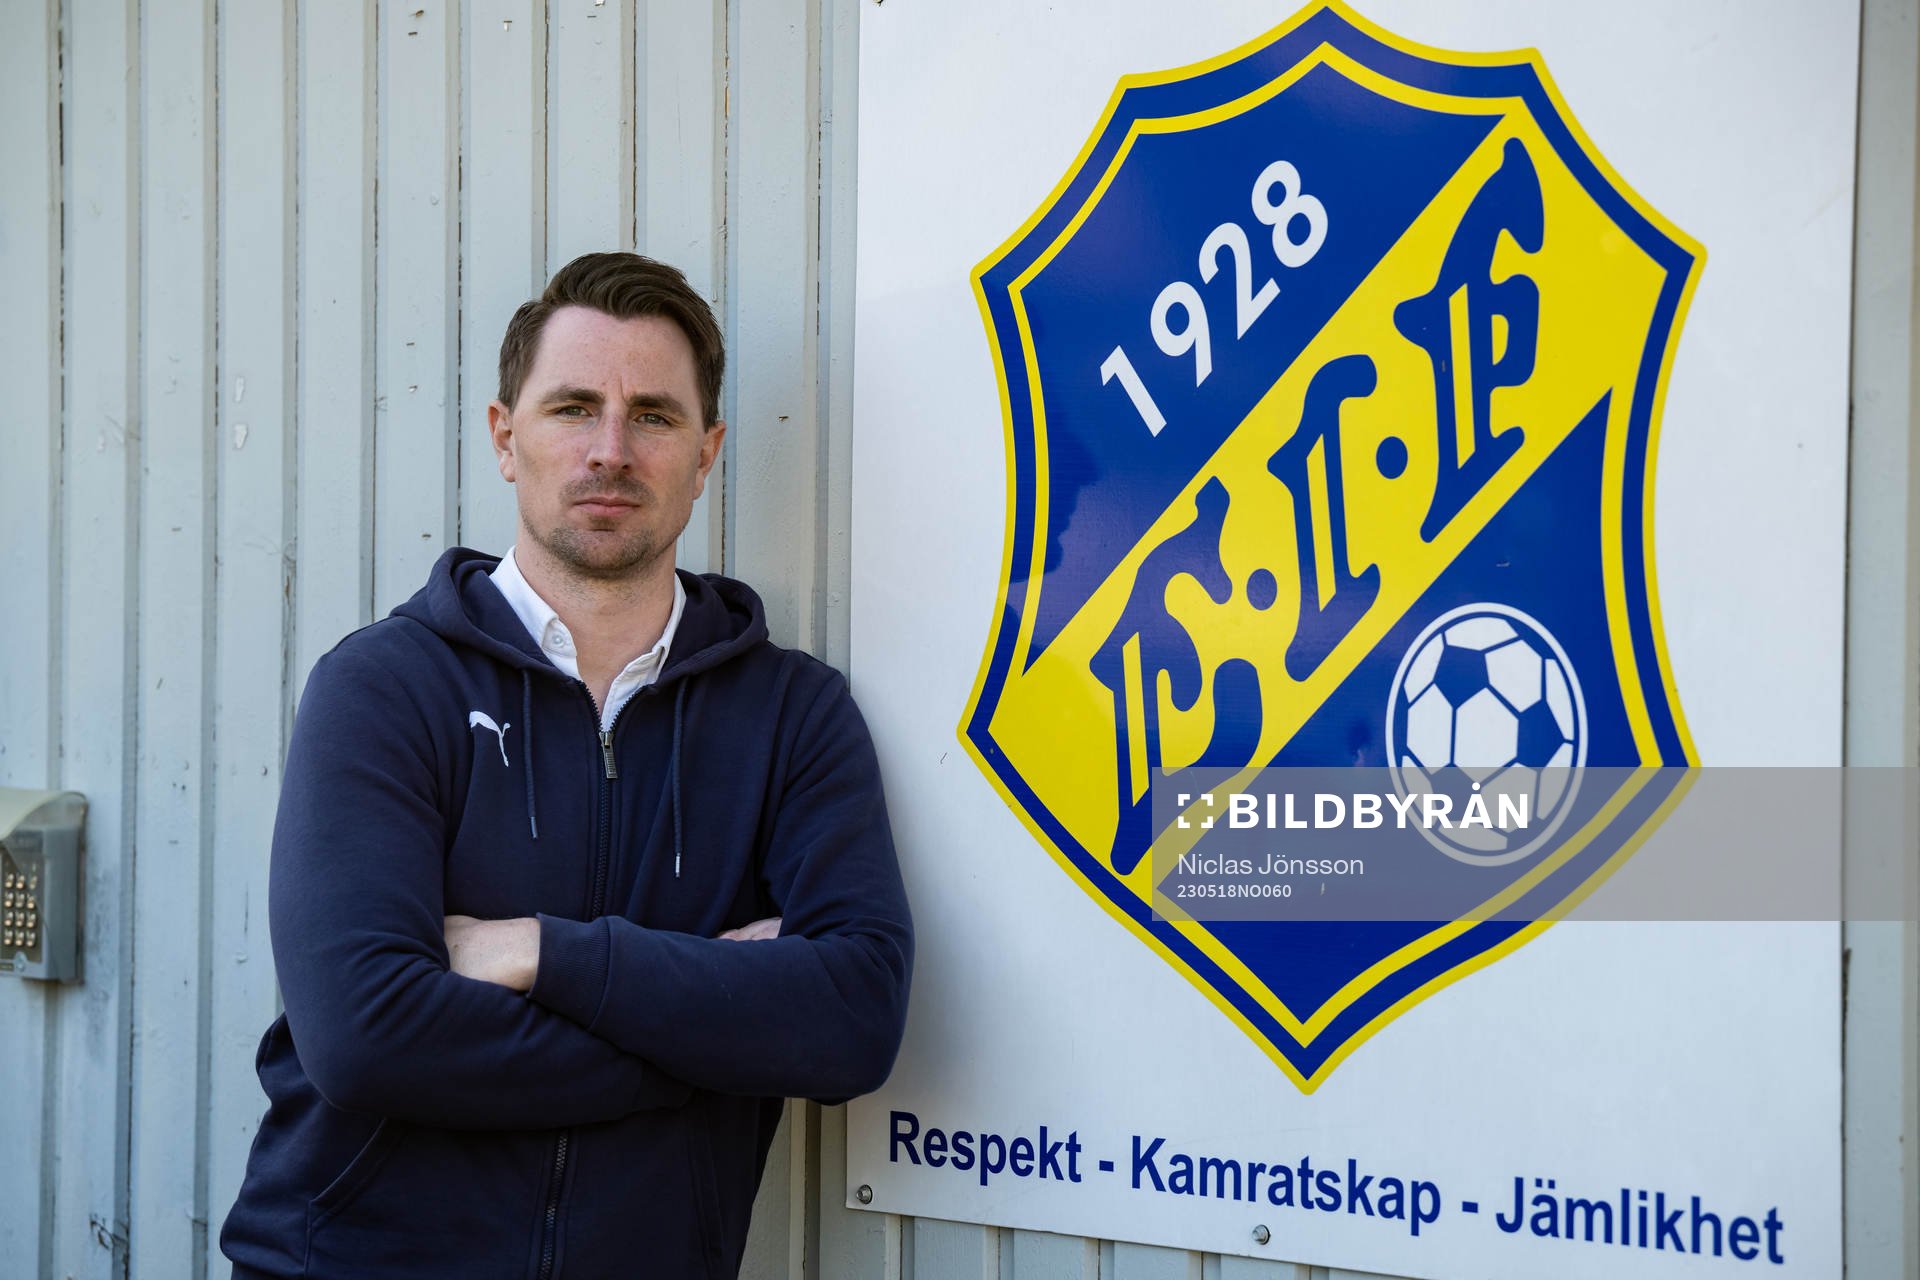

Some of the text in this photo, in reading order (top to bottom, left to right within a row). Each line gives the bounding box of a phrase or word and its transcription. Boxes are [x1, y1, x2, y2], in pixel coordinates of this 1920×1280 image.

[1100, 160, 1328, 437] 1928
[888, 1110, 1082, 1187] Respekt
[1131, 1135, 1441, 1236] Kamratskap
[1495, 1176, 1785, 1265] Jämlikhet
